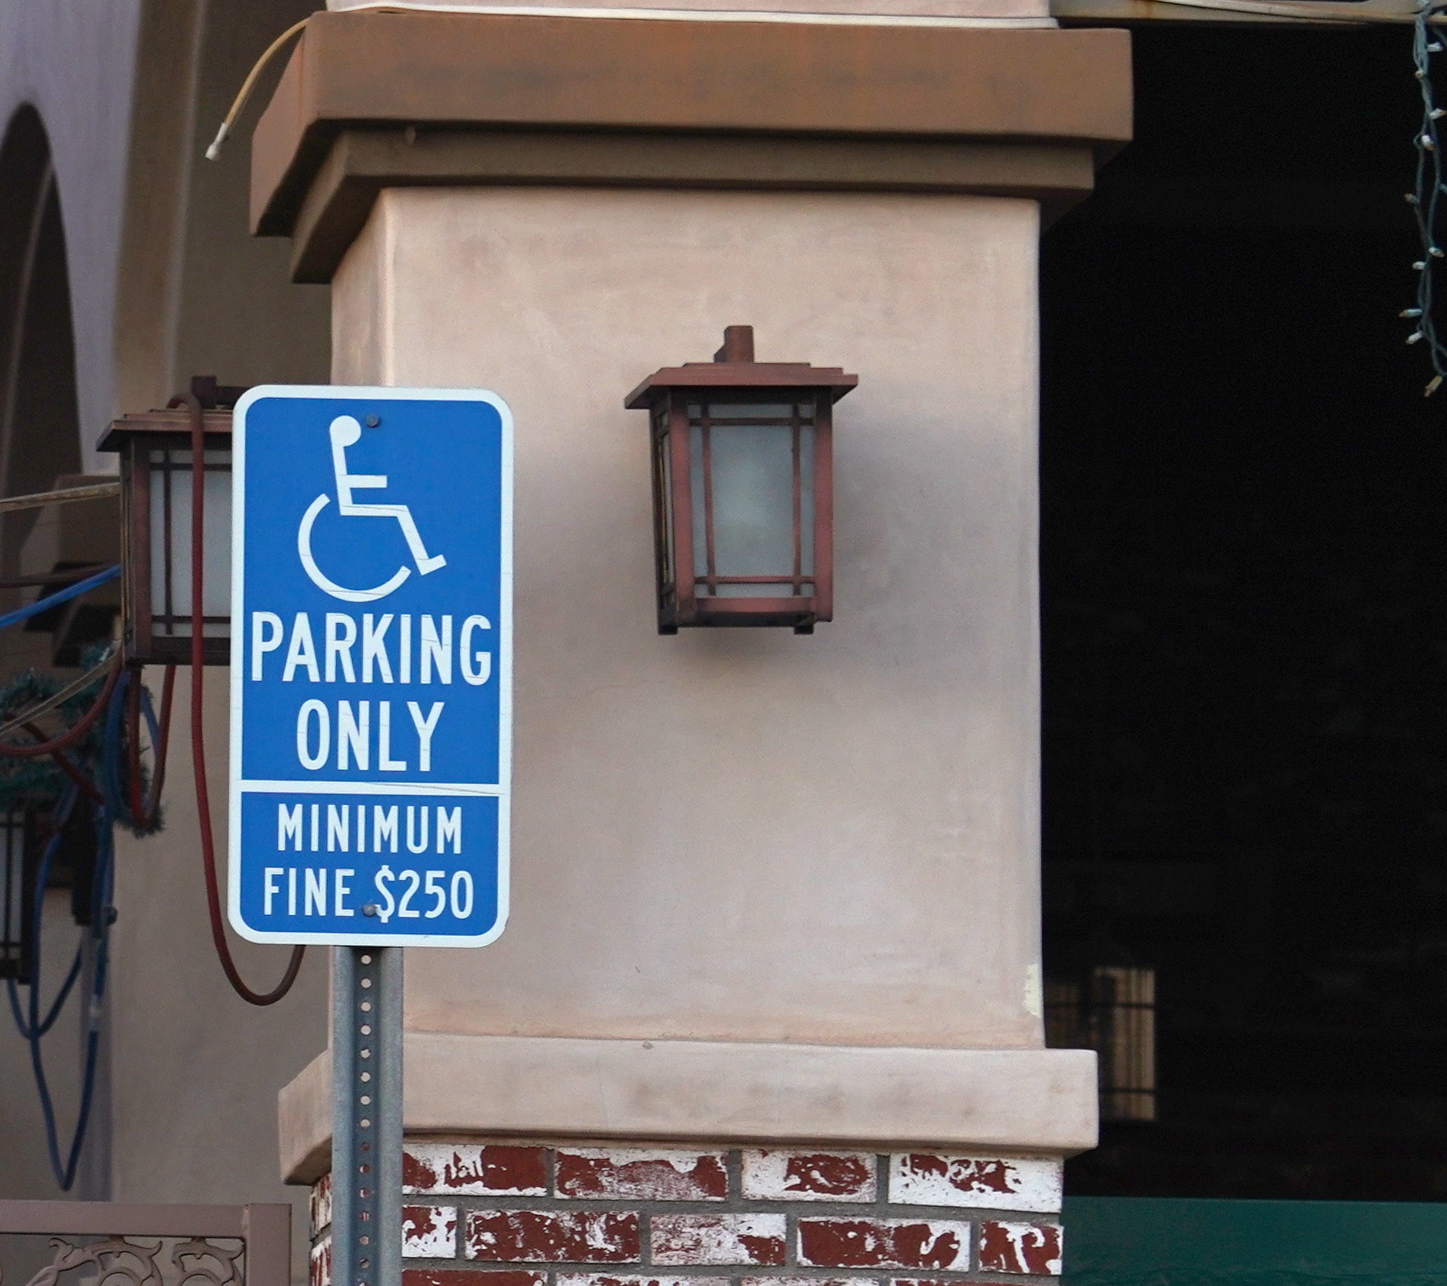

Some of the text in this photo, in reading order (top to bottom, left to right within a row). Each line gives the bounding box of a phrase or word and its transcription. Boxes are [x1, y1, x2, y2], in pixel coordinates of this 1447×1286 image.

[251, 611, 492, 686] PARKING
[296, 698, 445, 772] ONLY
[277, 803, 462, 855] MINIMUM
[264, 864, 474, 924] FINE $250
